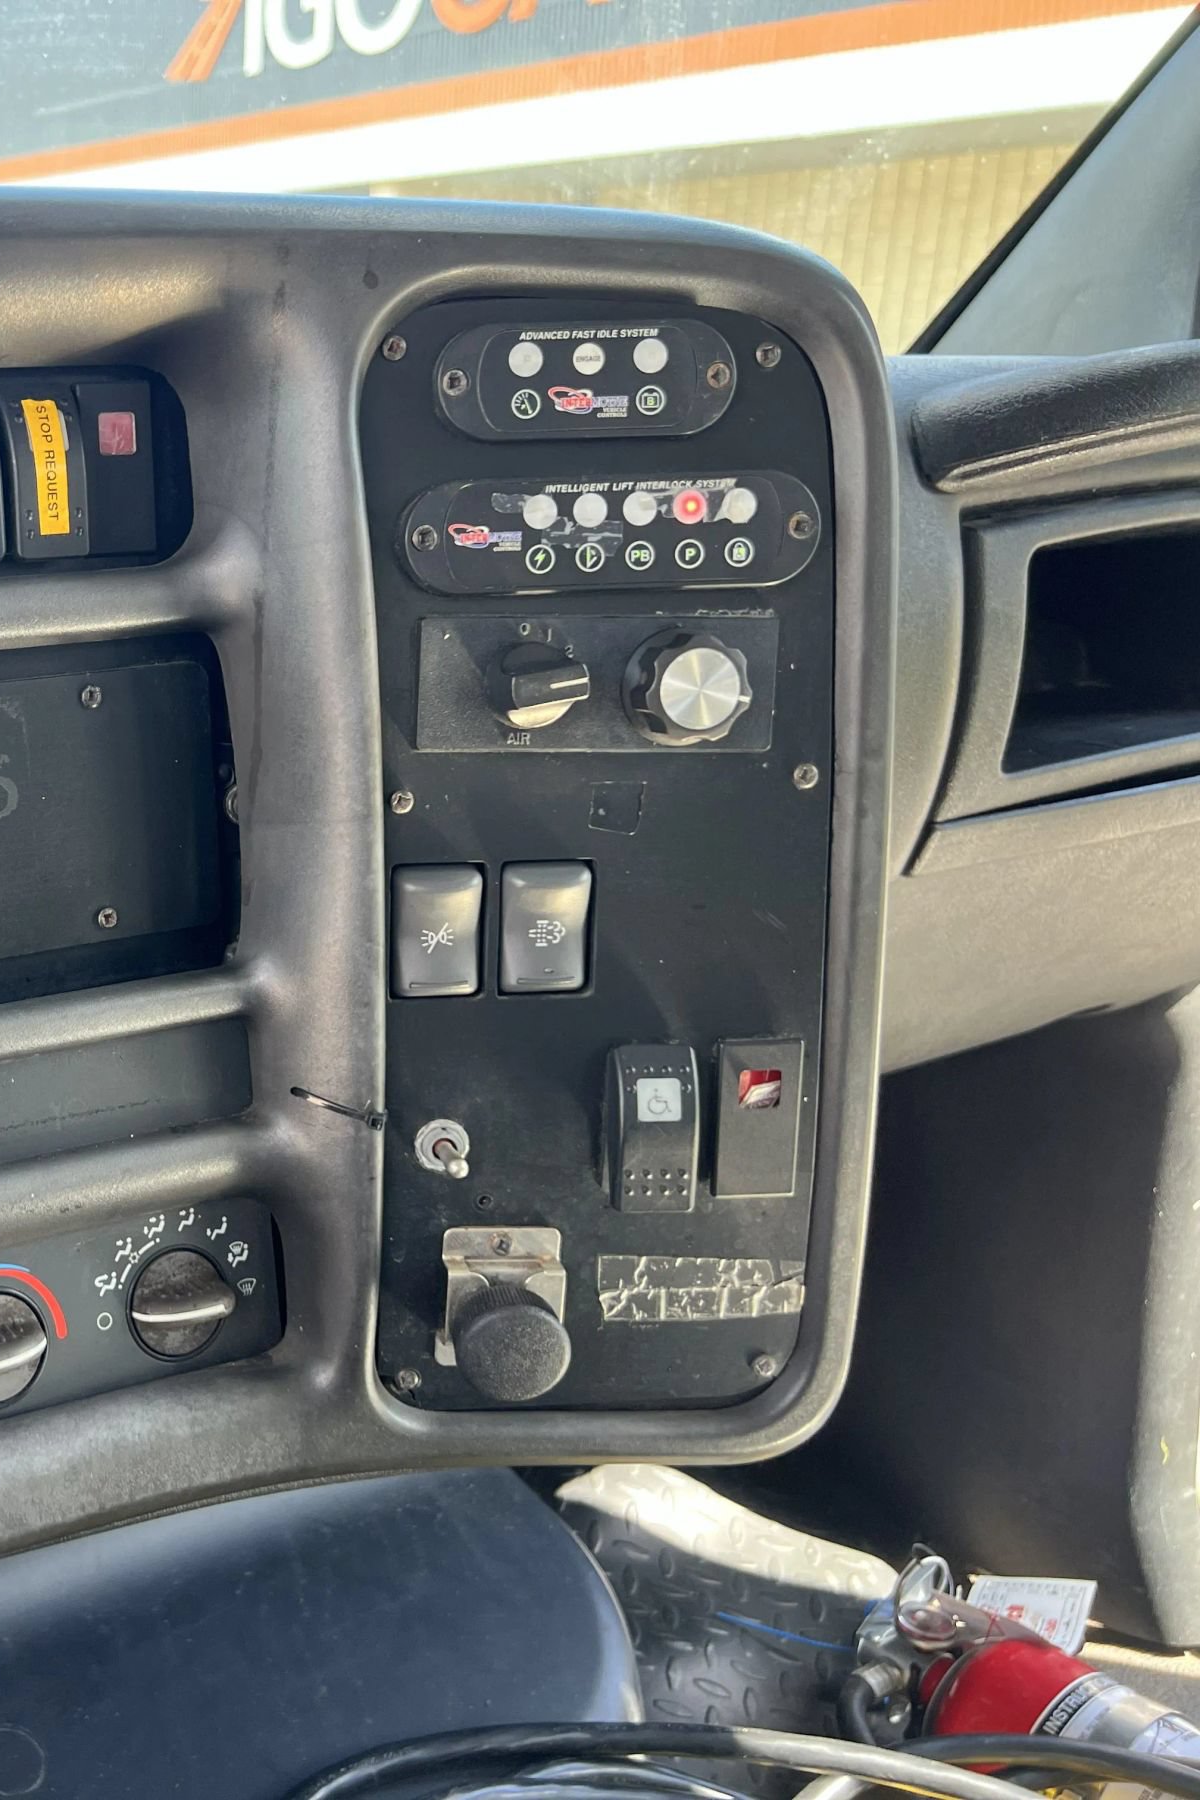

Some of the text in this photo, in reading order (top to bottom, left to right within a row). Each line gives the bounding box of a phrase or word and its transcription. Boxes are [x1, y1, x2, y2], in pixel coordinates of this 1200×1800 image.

[519, 328, 659, 340] ADVANCED FAST IDLE SYSTEM
[36, 405, 60, 521] STOP REQUEST
[545, 478, 737, 494] INTELLIGENT LIFT INTERLOCK SYSTEM
[630, 549, 650, 562] PB
[685, 548, 697, 561] P
[564, 644, 575, 658] 2
[506, 732, 531, 745] AIR
